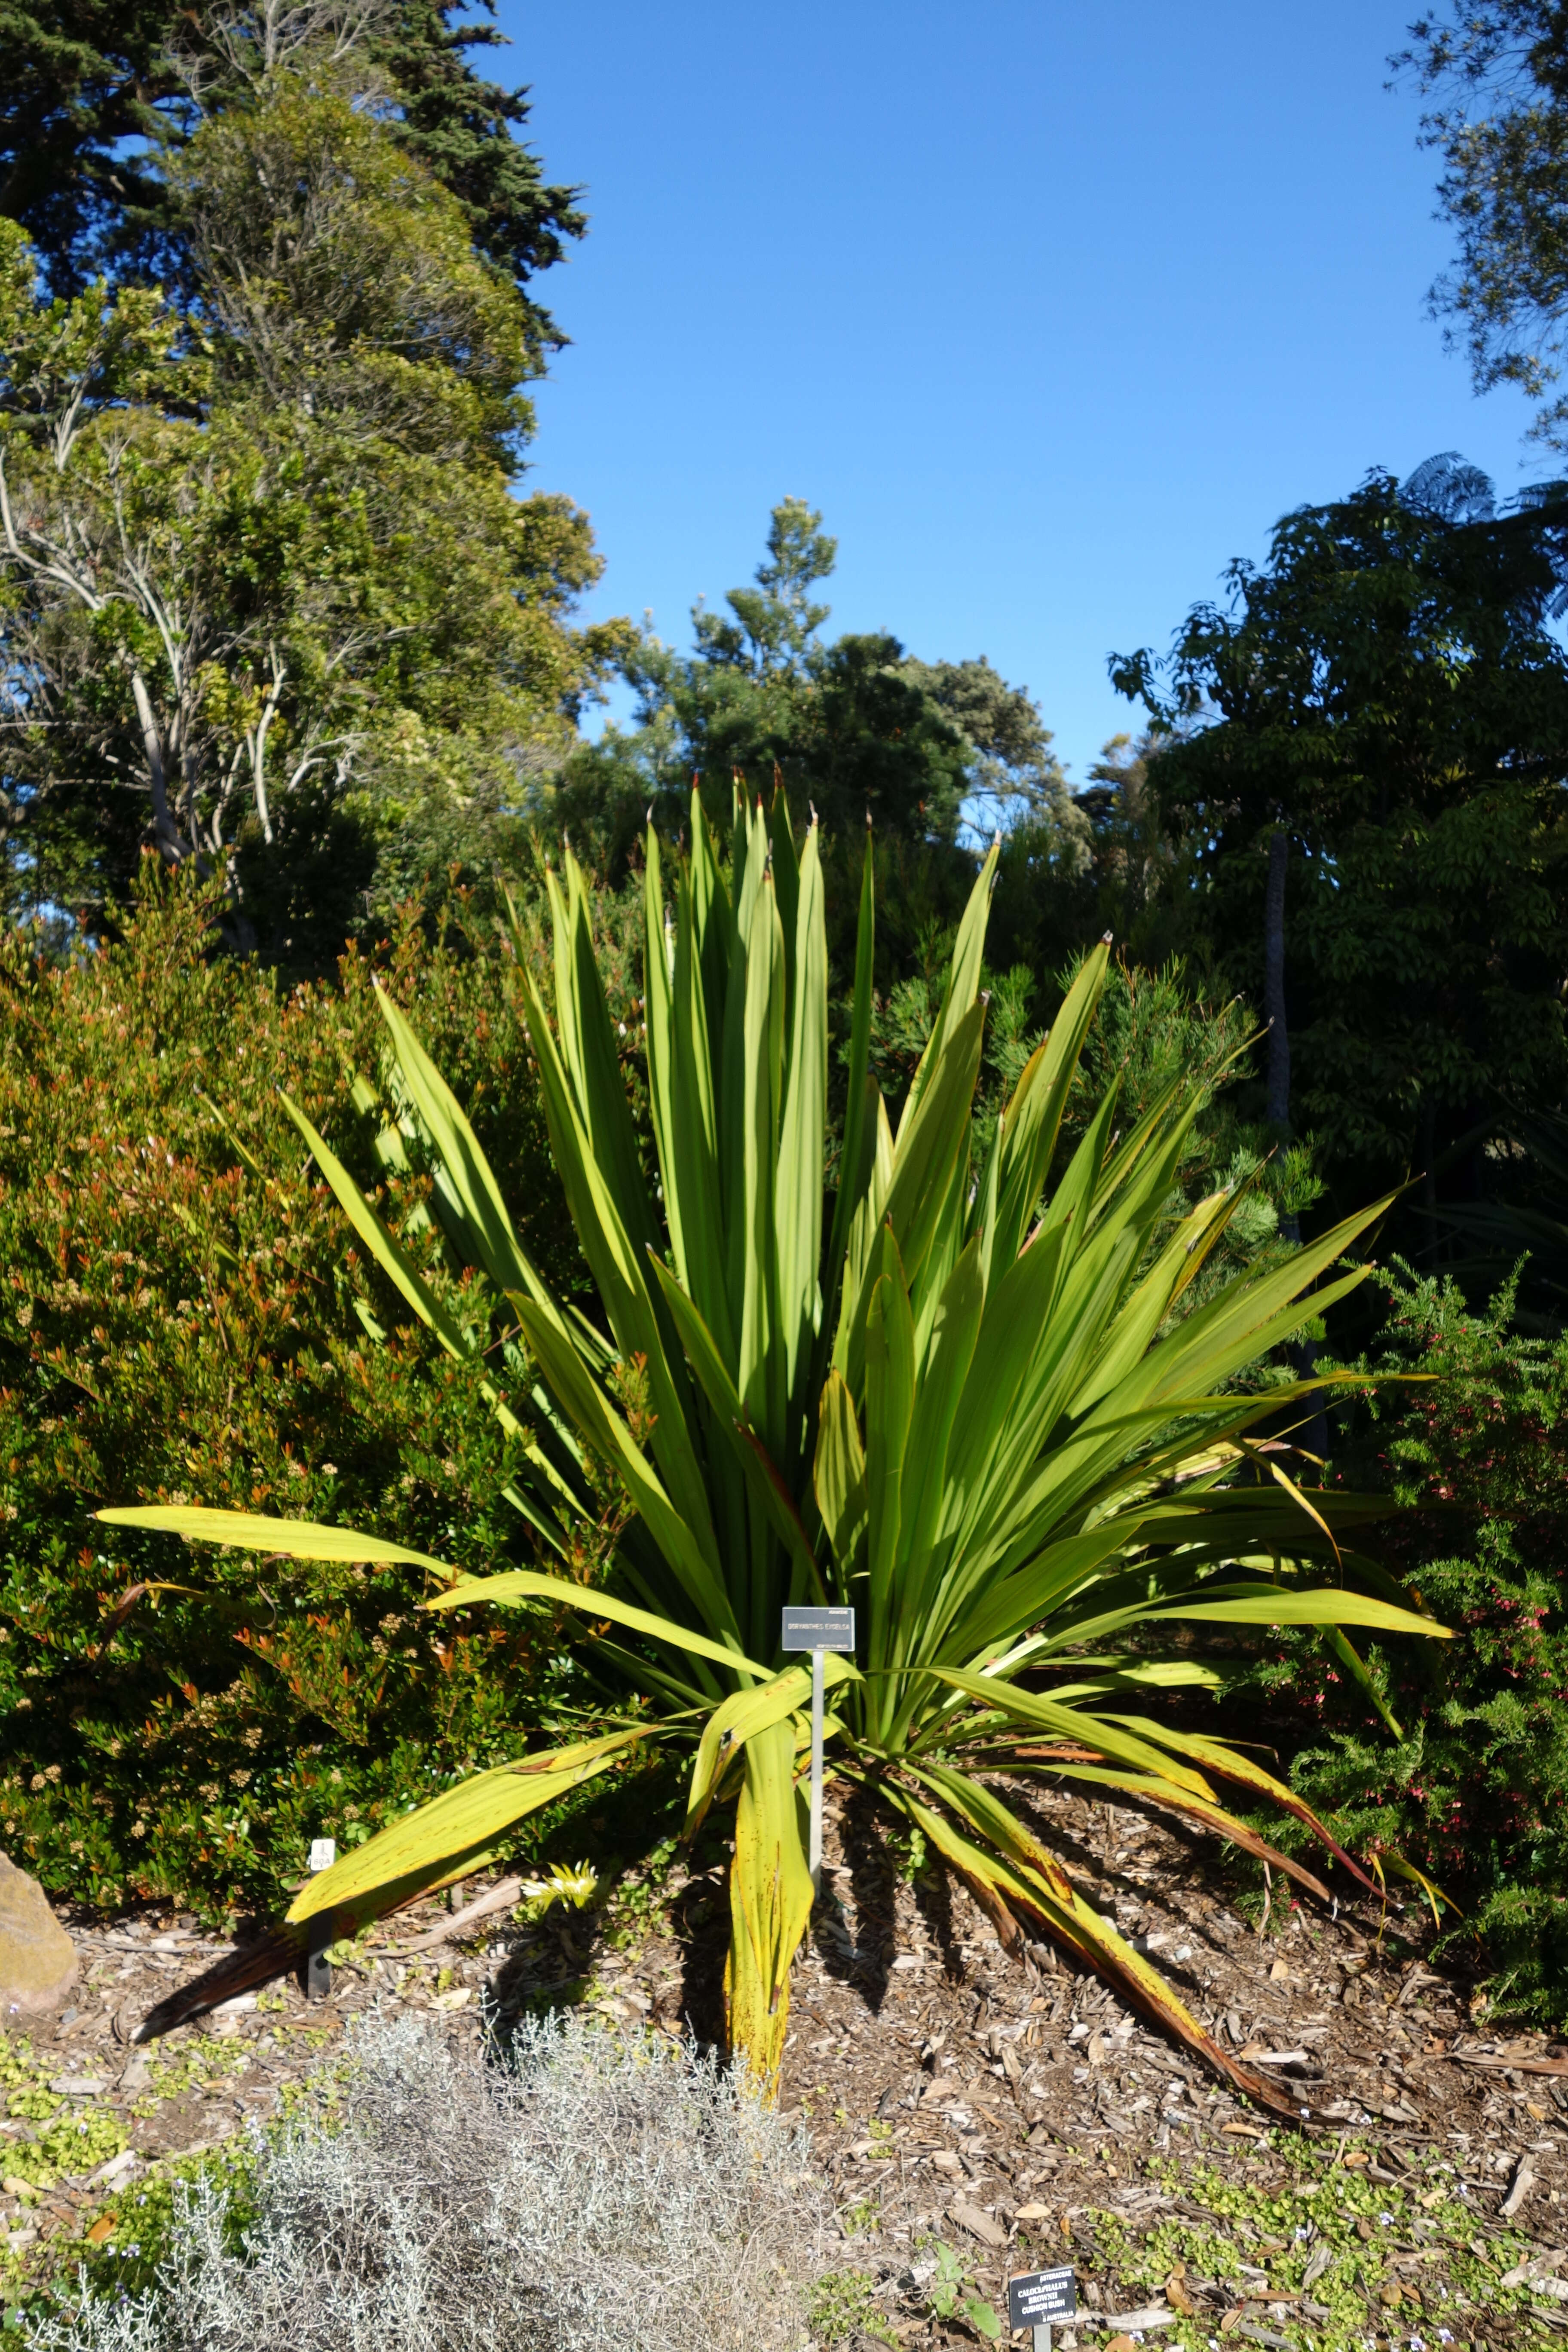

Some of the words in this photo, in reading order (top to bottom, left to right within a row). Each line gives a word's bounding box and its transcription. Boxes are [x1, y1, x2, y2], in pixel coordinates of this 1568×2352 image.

[1040, 2270, 1072, 2281] ASTERACEAE
[1018, 2281, 1068, 2298] CALOCEPHALUS
[1022, 2303, 1047, 2314] CUSHION
[1048, 2299, 1065, 2309] BUSH
[1047, 2311, 1074, 2321] AUSTRALIA
